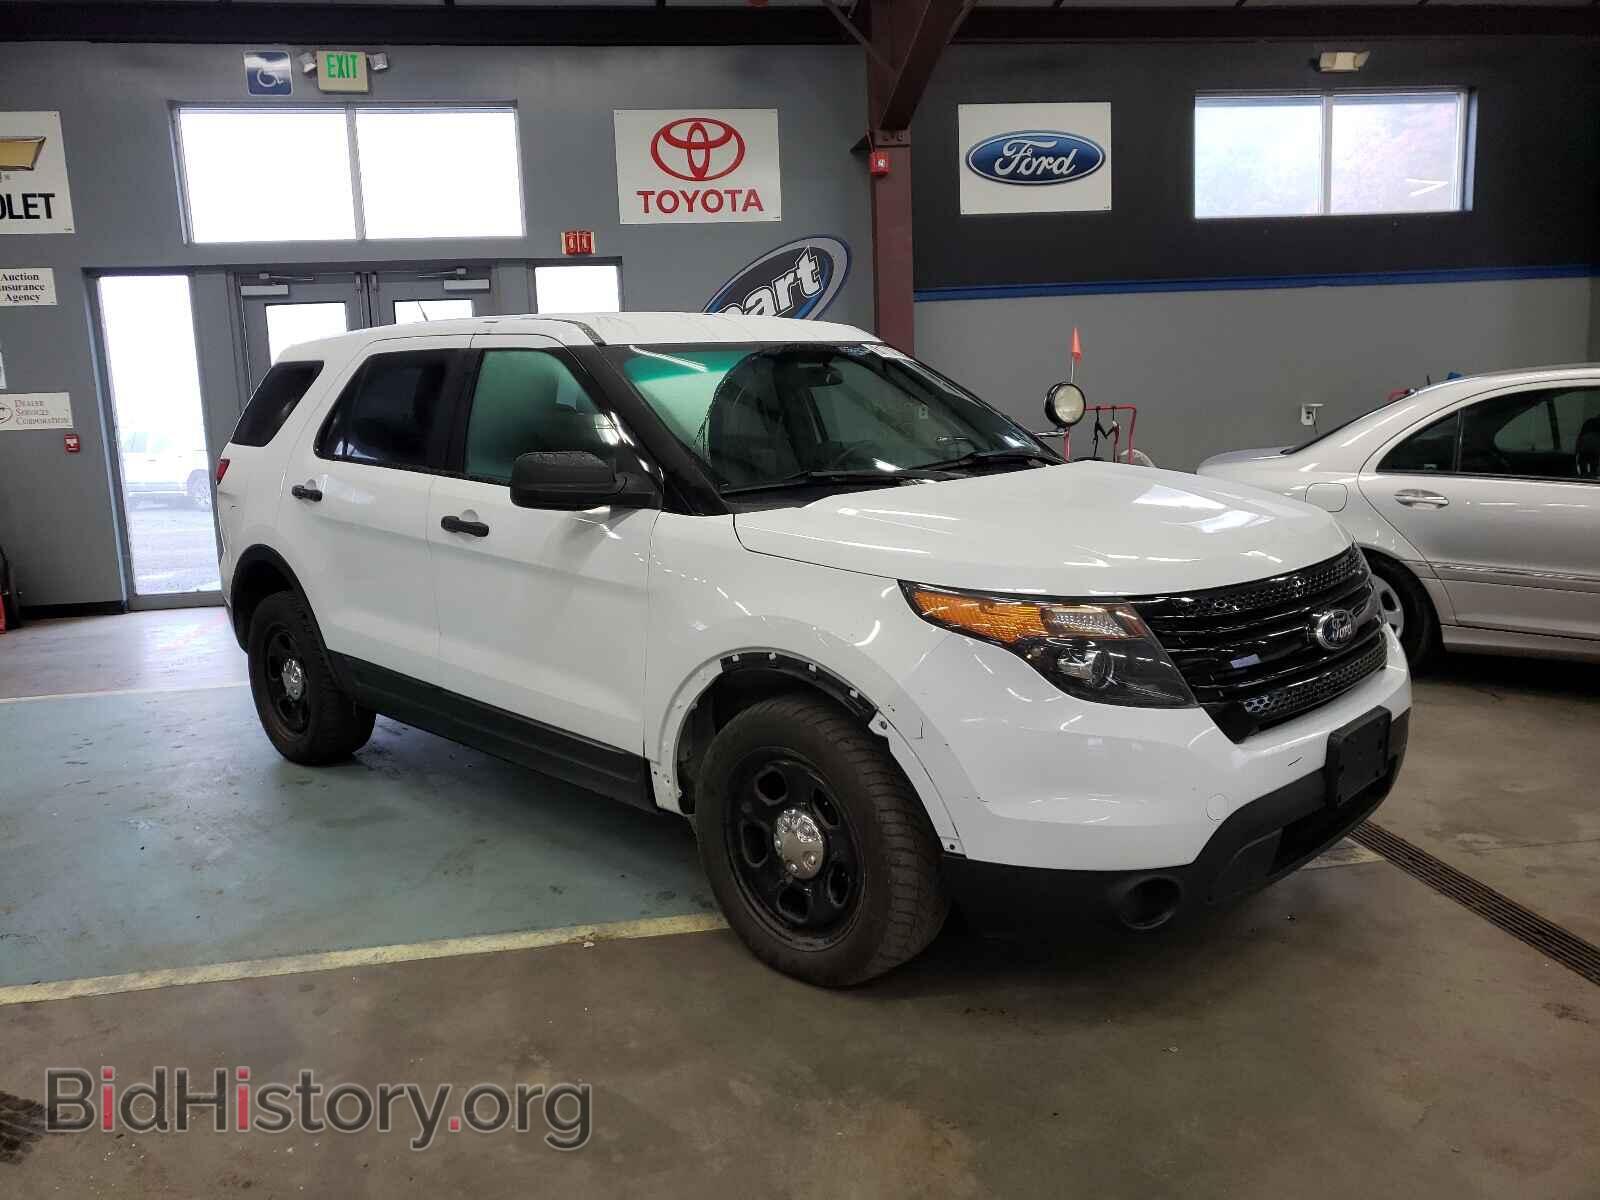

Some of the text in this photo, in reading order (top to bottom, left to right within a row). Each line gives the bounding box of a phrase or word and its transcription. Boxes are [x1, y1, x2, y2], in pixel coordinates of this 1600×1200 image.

[326, 54, 358, 79] EXIT
[994, 139, 1079, 176] Ford
[636, 188, 764, 214] TOYOTA
[1, 272, 40, 281] Auction
[4, 294, 41, 303] Agency
